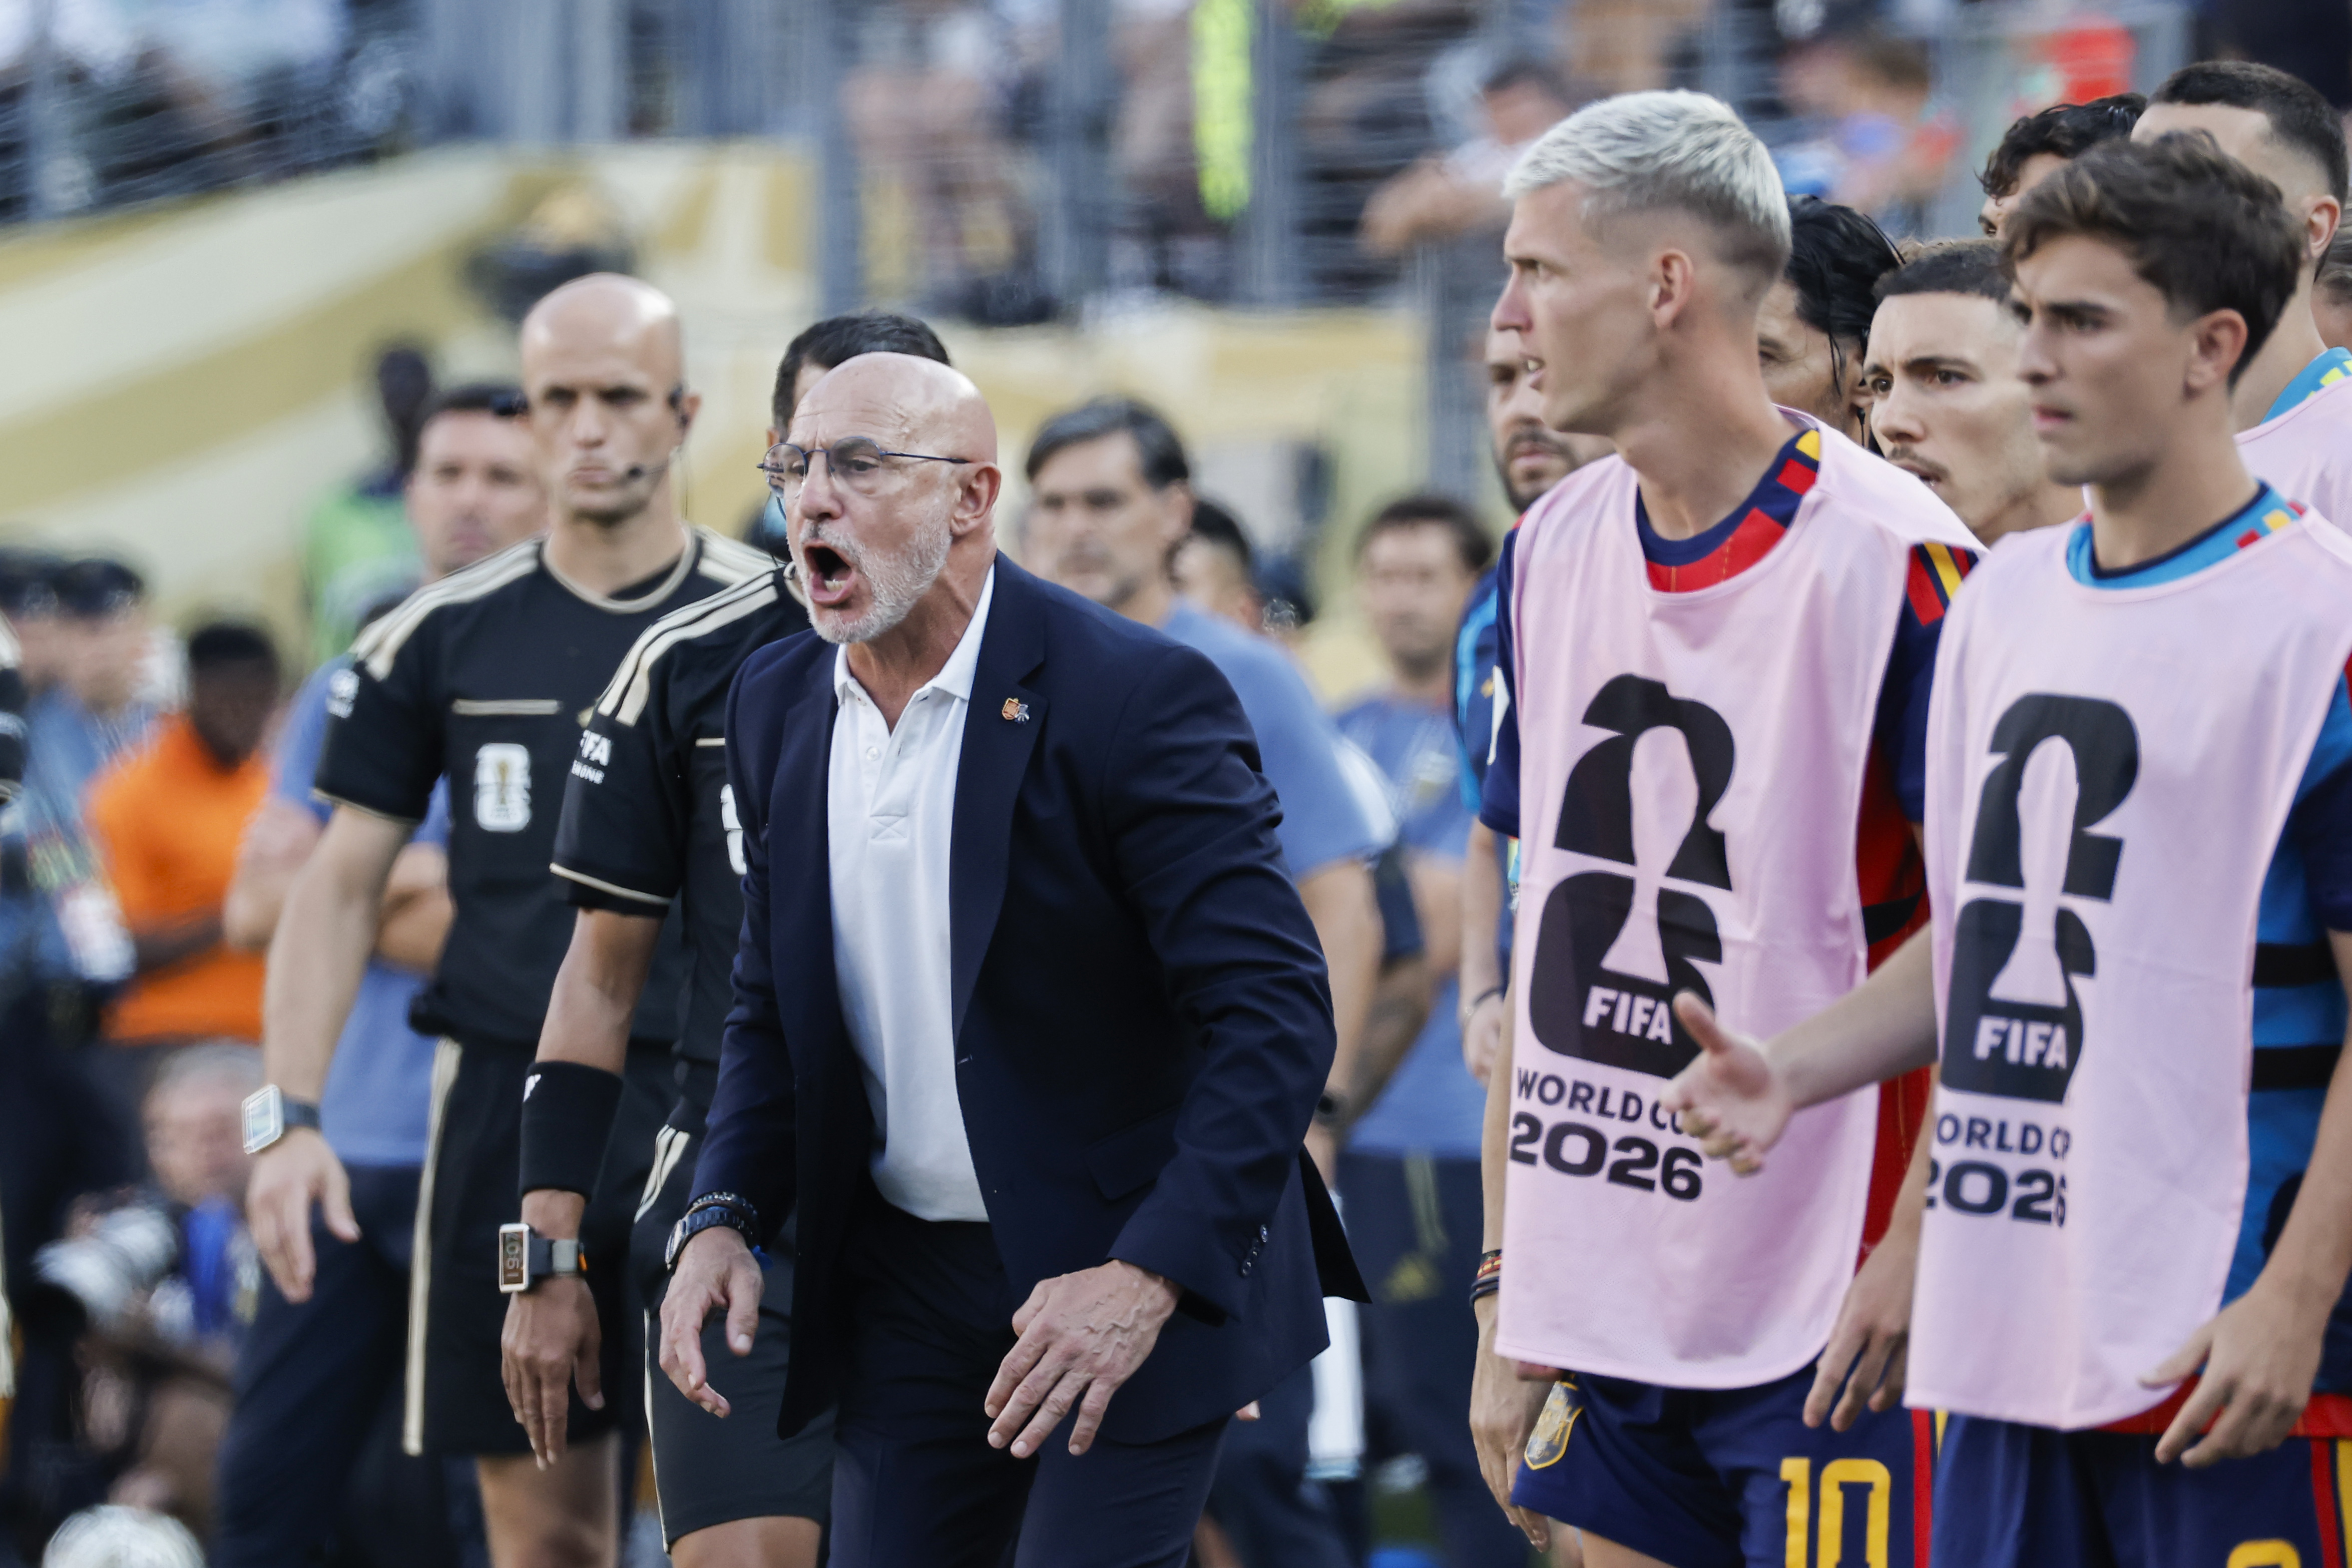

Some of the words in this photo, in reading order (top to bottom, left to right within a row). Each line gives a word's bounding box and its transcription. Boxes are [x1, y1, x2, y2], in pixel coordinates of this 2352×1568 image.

[1582, 985, 1673, 1046] FIFA
[1973, 1014, 2068, 1070] FIFA
[1517, 1067, 1643, 1123] WORLD
[1510, 1111, 1703, 1201] 2026
[1936, 1113, 2043, 1155] ORLD
[1779, 1456, 1892, 1568] 10
